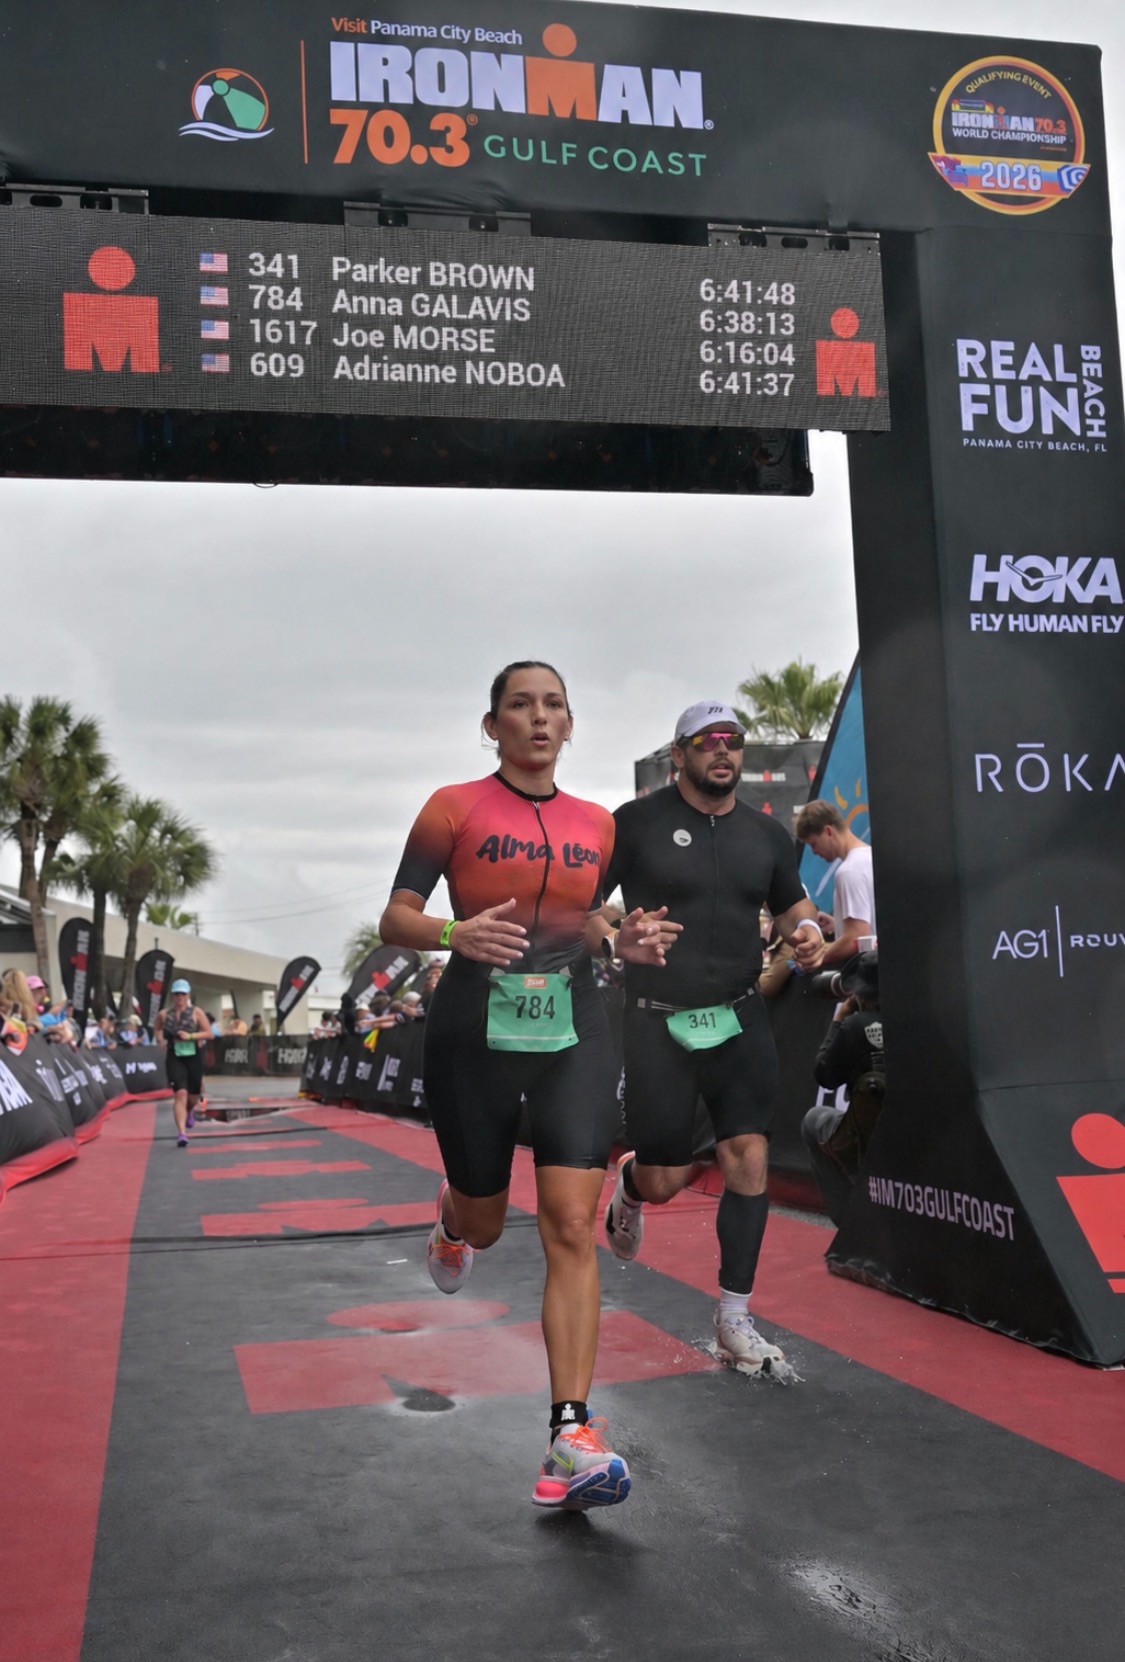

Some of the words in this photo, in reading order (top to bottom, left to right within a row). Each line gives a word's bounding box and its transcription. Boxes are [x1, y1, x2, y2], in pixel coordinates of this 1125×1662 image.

[331, 17, 367, 33] Visit
[370, 20, 438, 38] Panama
[440, 24, 471, 43] City
[474, 27, 523, 45] Beach
[966, 71, 1021, 93] QUALIFYING
[1022, 75, 1052, 99] EVENT
[951, 111, 1035, 132] IRONMAN
[1035, 117, 1067, 134] 70.3
[952, 127, 989, 139] WORLD
[991, 130, 1066, 144] CHAMPIONSHIP
[484, 134, 577, 166] GULF
[588, 146, 707, 176] COAST
[980, 161, 1042, 192] 2026
[248, 252, 300, 279] 341
[332, 256, 421, 286] Parker
[430, 260, 535, 291] BROWN
[699, 278, 796, 306] 6:41:48
[248, 284, 303, 311] 784
[332, 289, 402, 316] Anna
[411, 292, 531, 322] GALAVIS
[699, 309, 796, 336] 6:38:13
[249, 318, 317, 346] 1617
[332, 322, 385, 349] Joe
[393, 325, 496, 353] MORSE
[699, 340, 796, 367] 6:16:04
[250, 352, 305, 378] 609
[333, 355, 457, 384] Adrianne
[465, 360, 566, 388] NOBOA
[699, 371, 796, 397] 6:41:37
[956, 338, 1078, 383] REAL
[1080, 344, 1107, 438] BEACH
[959, 383, 1081, 436] FUN
[963, 438, 1012, 449] PANAMA
[1017, 440, 1043, 450] CITY
[1048, 441, 1090, 453] BEACH,
[1094, 443, 1108, 452] FL
[969, 553, 1124, 604] HOKA
[969, 613, 1004, 632] FLY
[1008, 613, 1089, 633] HUMAN
[1091, 614, 1125, 634] FLY
[475, 834, 556, 863] Alma
[992, 929, 1048, 960] AG1
[514, 995, 556, 1020] 784
[688, 1012, 718, 1029] 341
[868, 1175, 1015, 1241] #IM703GULFCOAST
